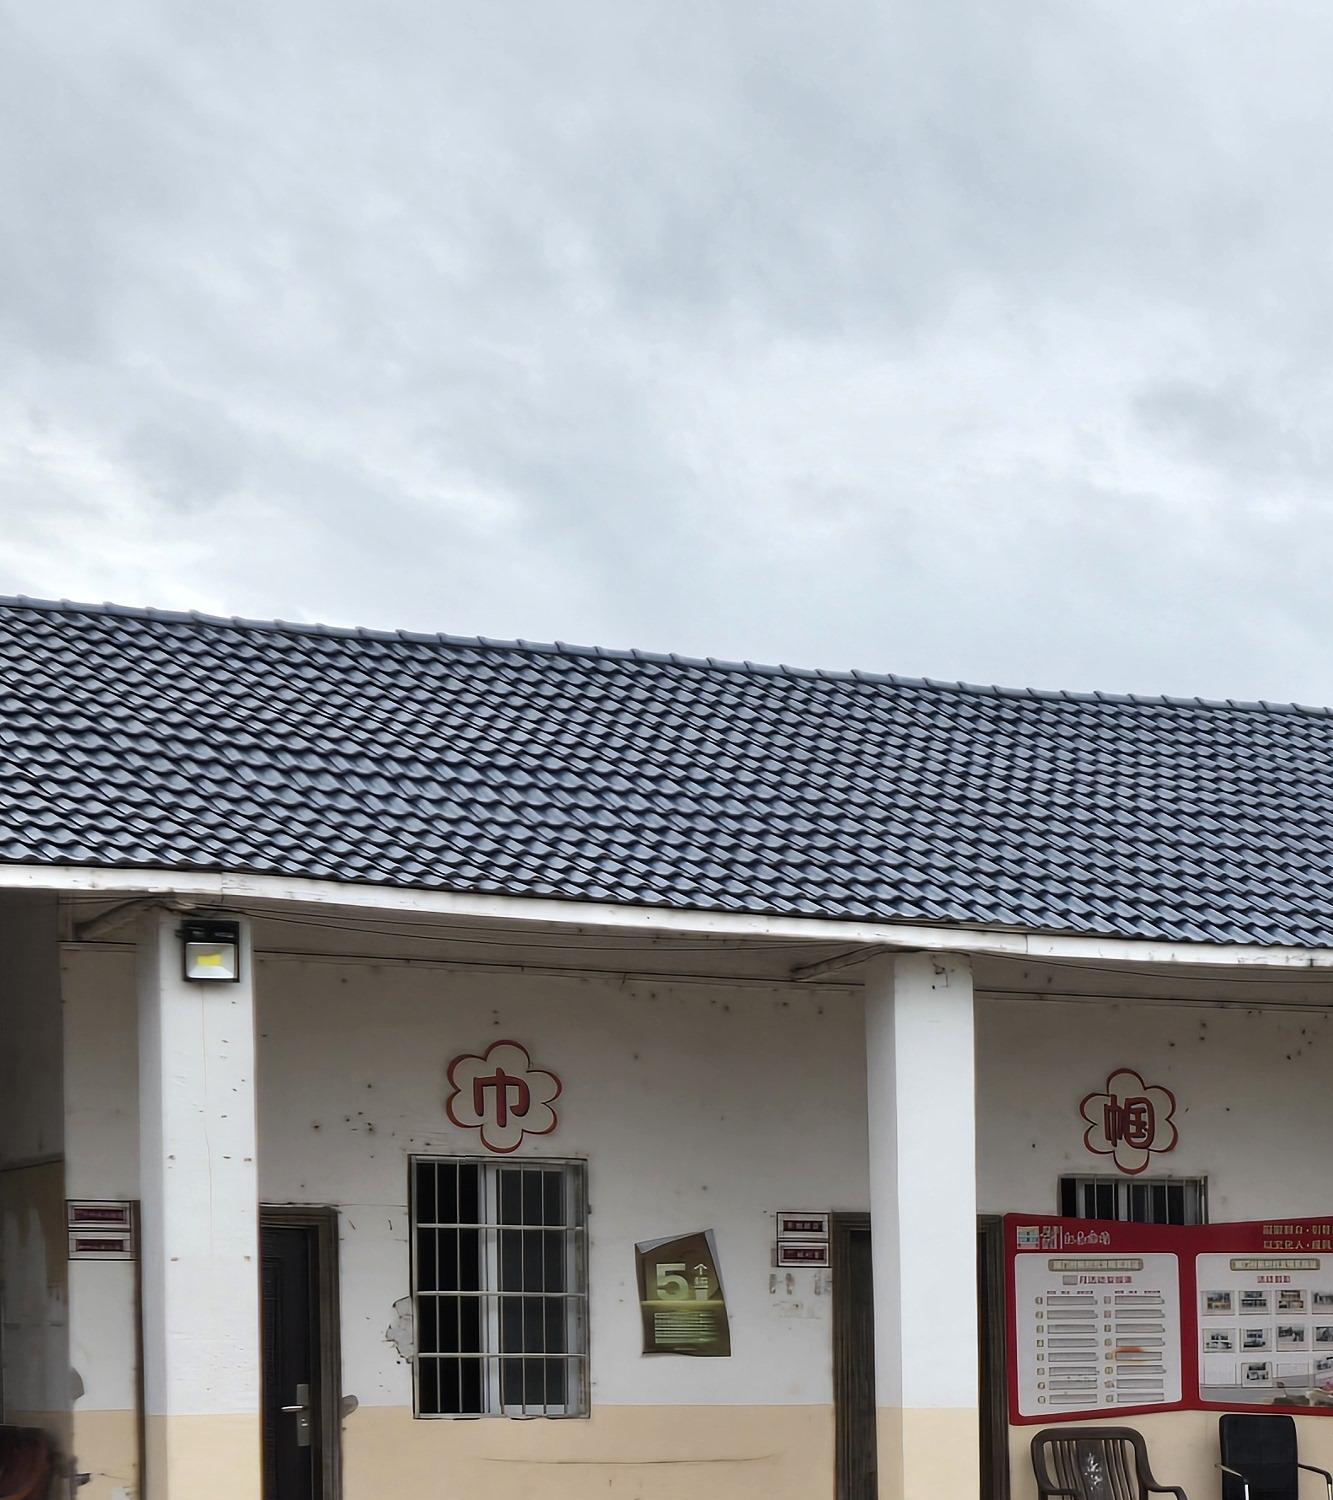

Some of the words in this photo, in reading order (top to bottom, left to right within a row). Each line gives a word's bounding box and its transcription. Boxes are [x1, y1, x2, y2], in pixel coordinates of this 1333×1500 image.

[473, 1067, 531, 1128] 巾
[1104, 1094, 1156, 1150] 帼
[656, 1263, 689, 1301] 5
